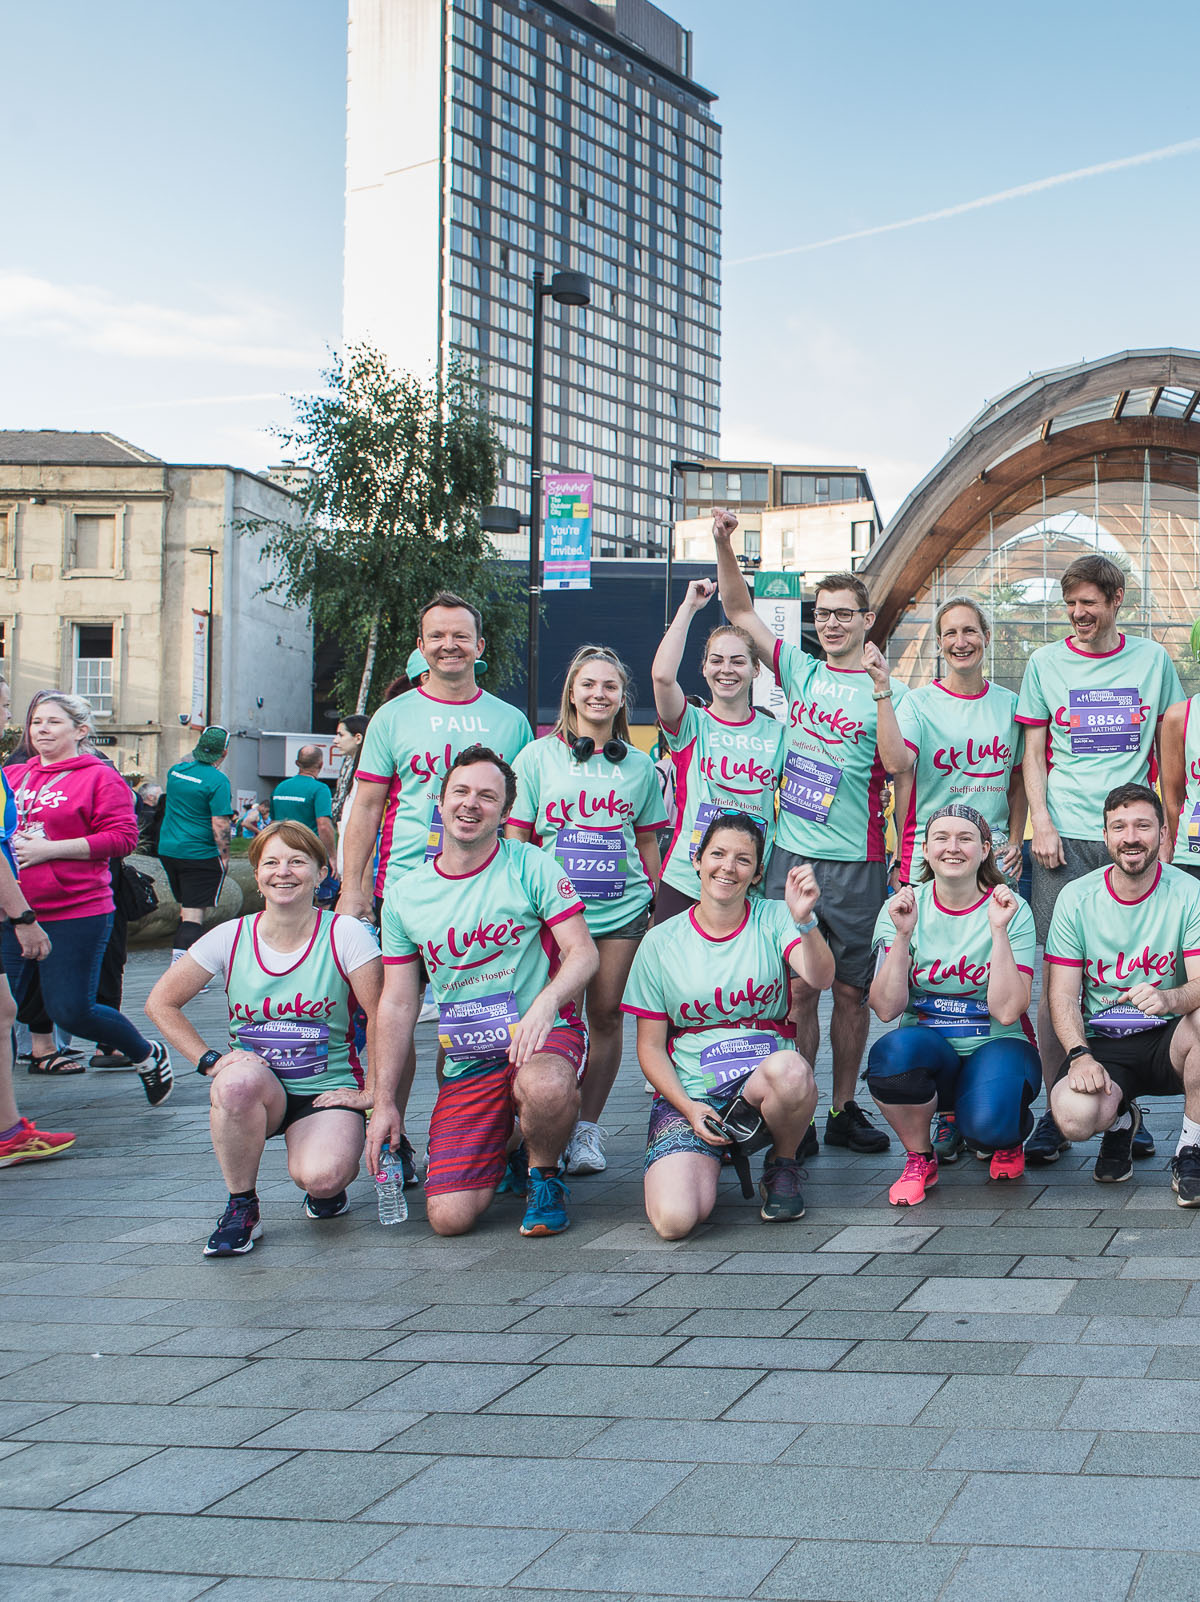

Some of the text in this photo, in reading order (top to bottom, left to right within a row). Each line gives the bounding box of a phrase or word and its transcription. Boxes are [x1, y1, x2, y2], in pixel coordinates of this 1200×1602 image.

[547, 481, 591, 495] Summer
[551, 525, 580, 536] You're
[551, 536, 563, 545] all
[551, 545, 584, 556] invited.
[771, 606, 785, 640] rden
[811, 680, 858, 701] MATT
[430, 716, 489, 732] PAUL
[790, 701, 867, 745] St Luke's
[1087, 714, 1125, 726] 8856
[709, 731, 777, 753] EORGE
[410, 751, 441, 783] St
[568, 762, 624, 780] ELLA
[933, 746, 963, 777] St
[721, 756, 778, 791] Luke's
[787, 780, 823, 802] 11719
[797, 799, 811, 807] TEAM
[546, 799, 575, 830] St
[568, 858, 616, 872] 12765
[447, 917, 526, 958] Luke's
[929, 955, 990, 987] Luke'
[1115, 945, 1177, 980] Luke's
[481, 967, 516, 982] Hospice
[262, 992, 337, 1022] Luke's
[468, 1002, 507, 1016] MARATHON
[680, 978, 783, 1025] St Luke's
[490, 1009, 508, 1017] 2020
[453, 1027, 508, 1046] 12230
[260, 1046, 307, 1060] 7217
